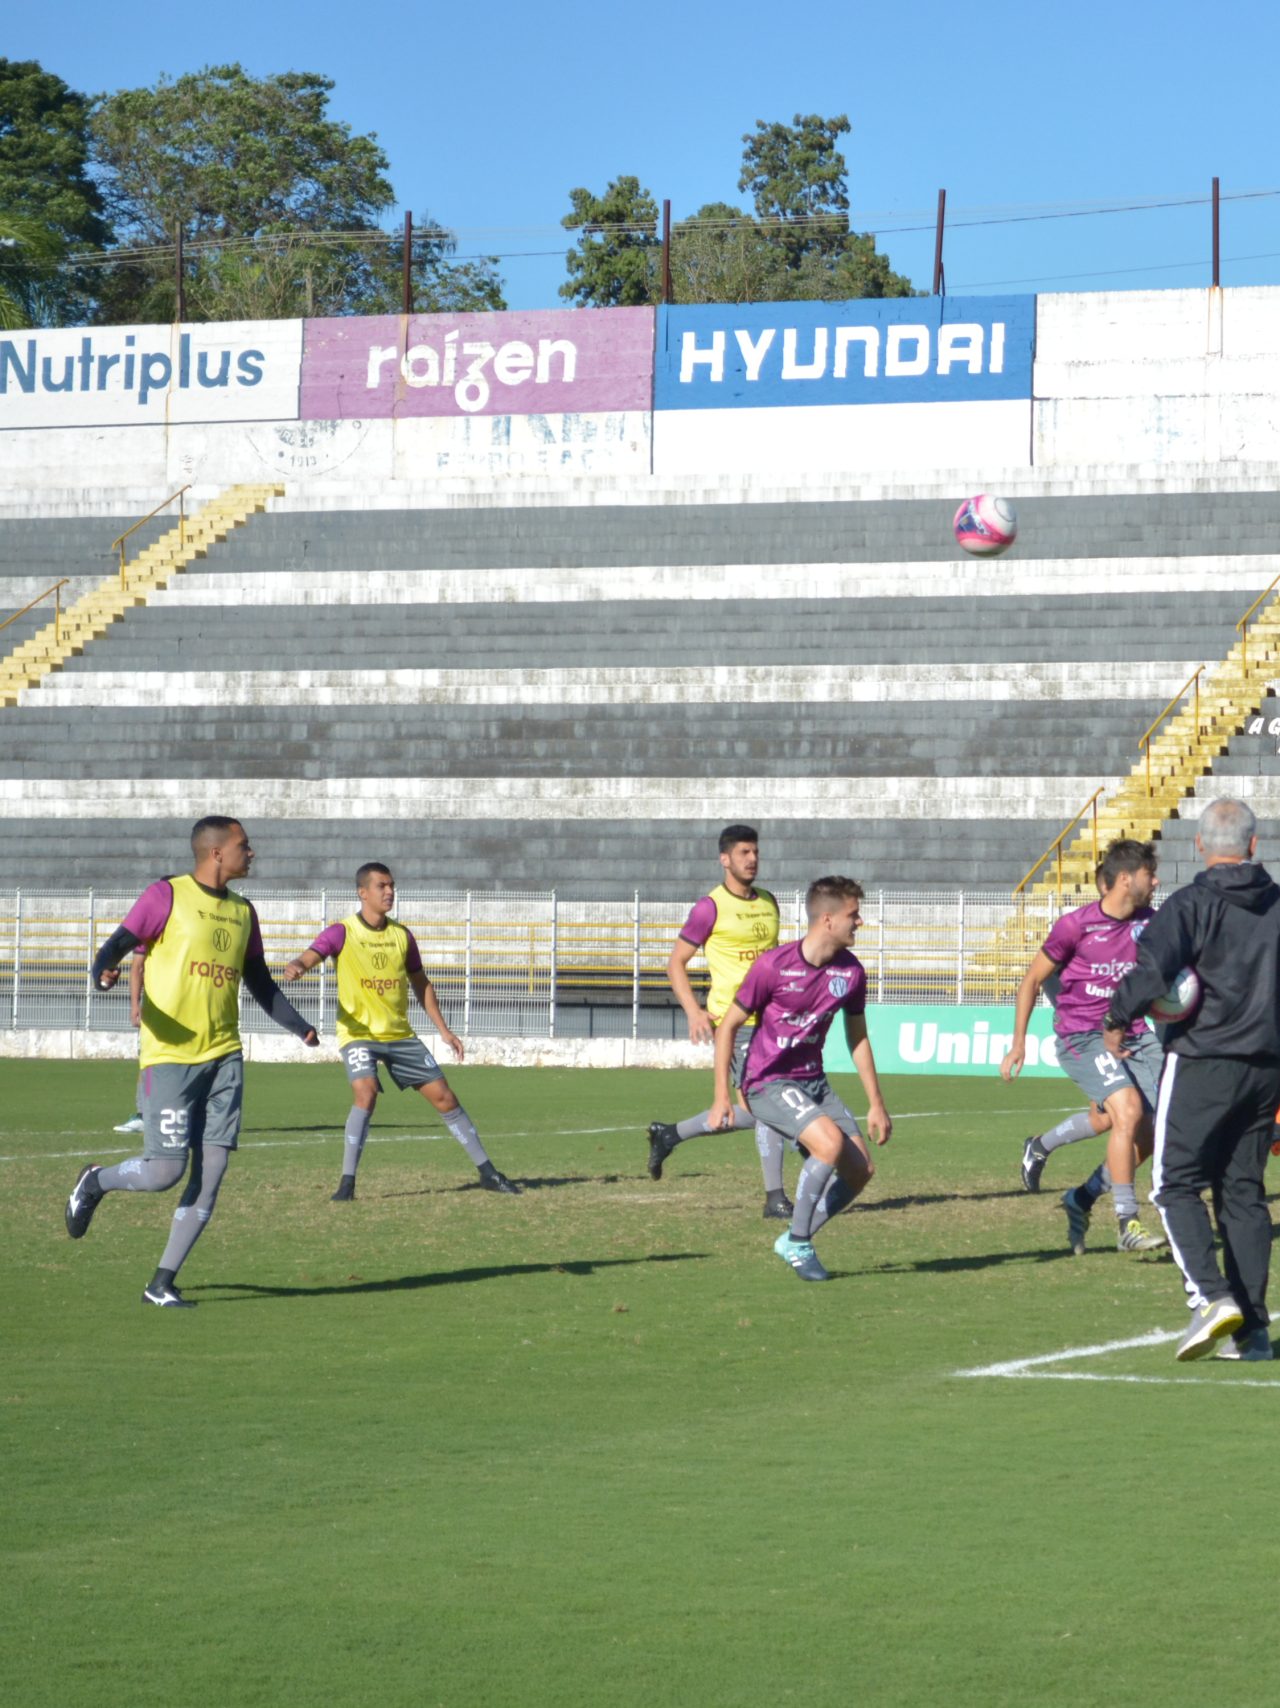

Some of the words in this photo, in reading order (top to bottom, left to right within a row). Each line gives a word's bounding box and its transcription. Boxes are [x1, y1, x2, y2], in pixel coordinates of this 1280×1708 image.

[679, 322, 1005, 383] HYUNDAI
[0, 333, 265, 405] Nutriplus
[1249, 717, 1265, 735] A
[829, 977, 848, 998] XV
[348, 1047, 370, 1065] 26
[1094, 1051, 1118, 1076] 14
